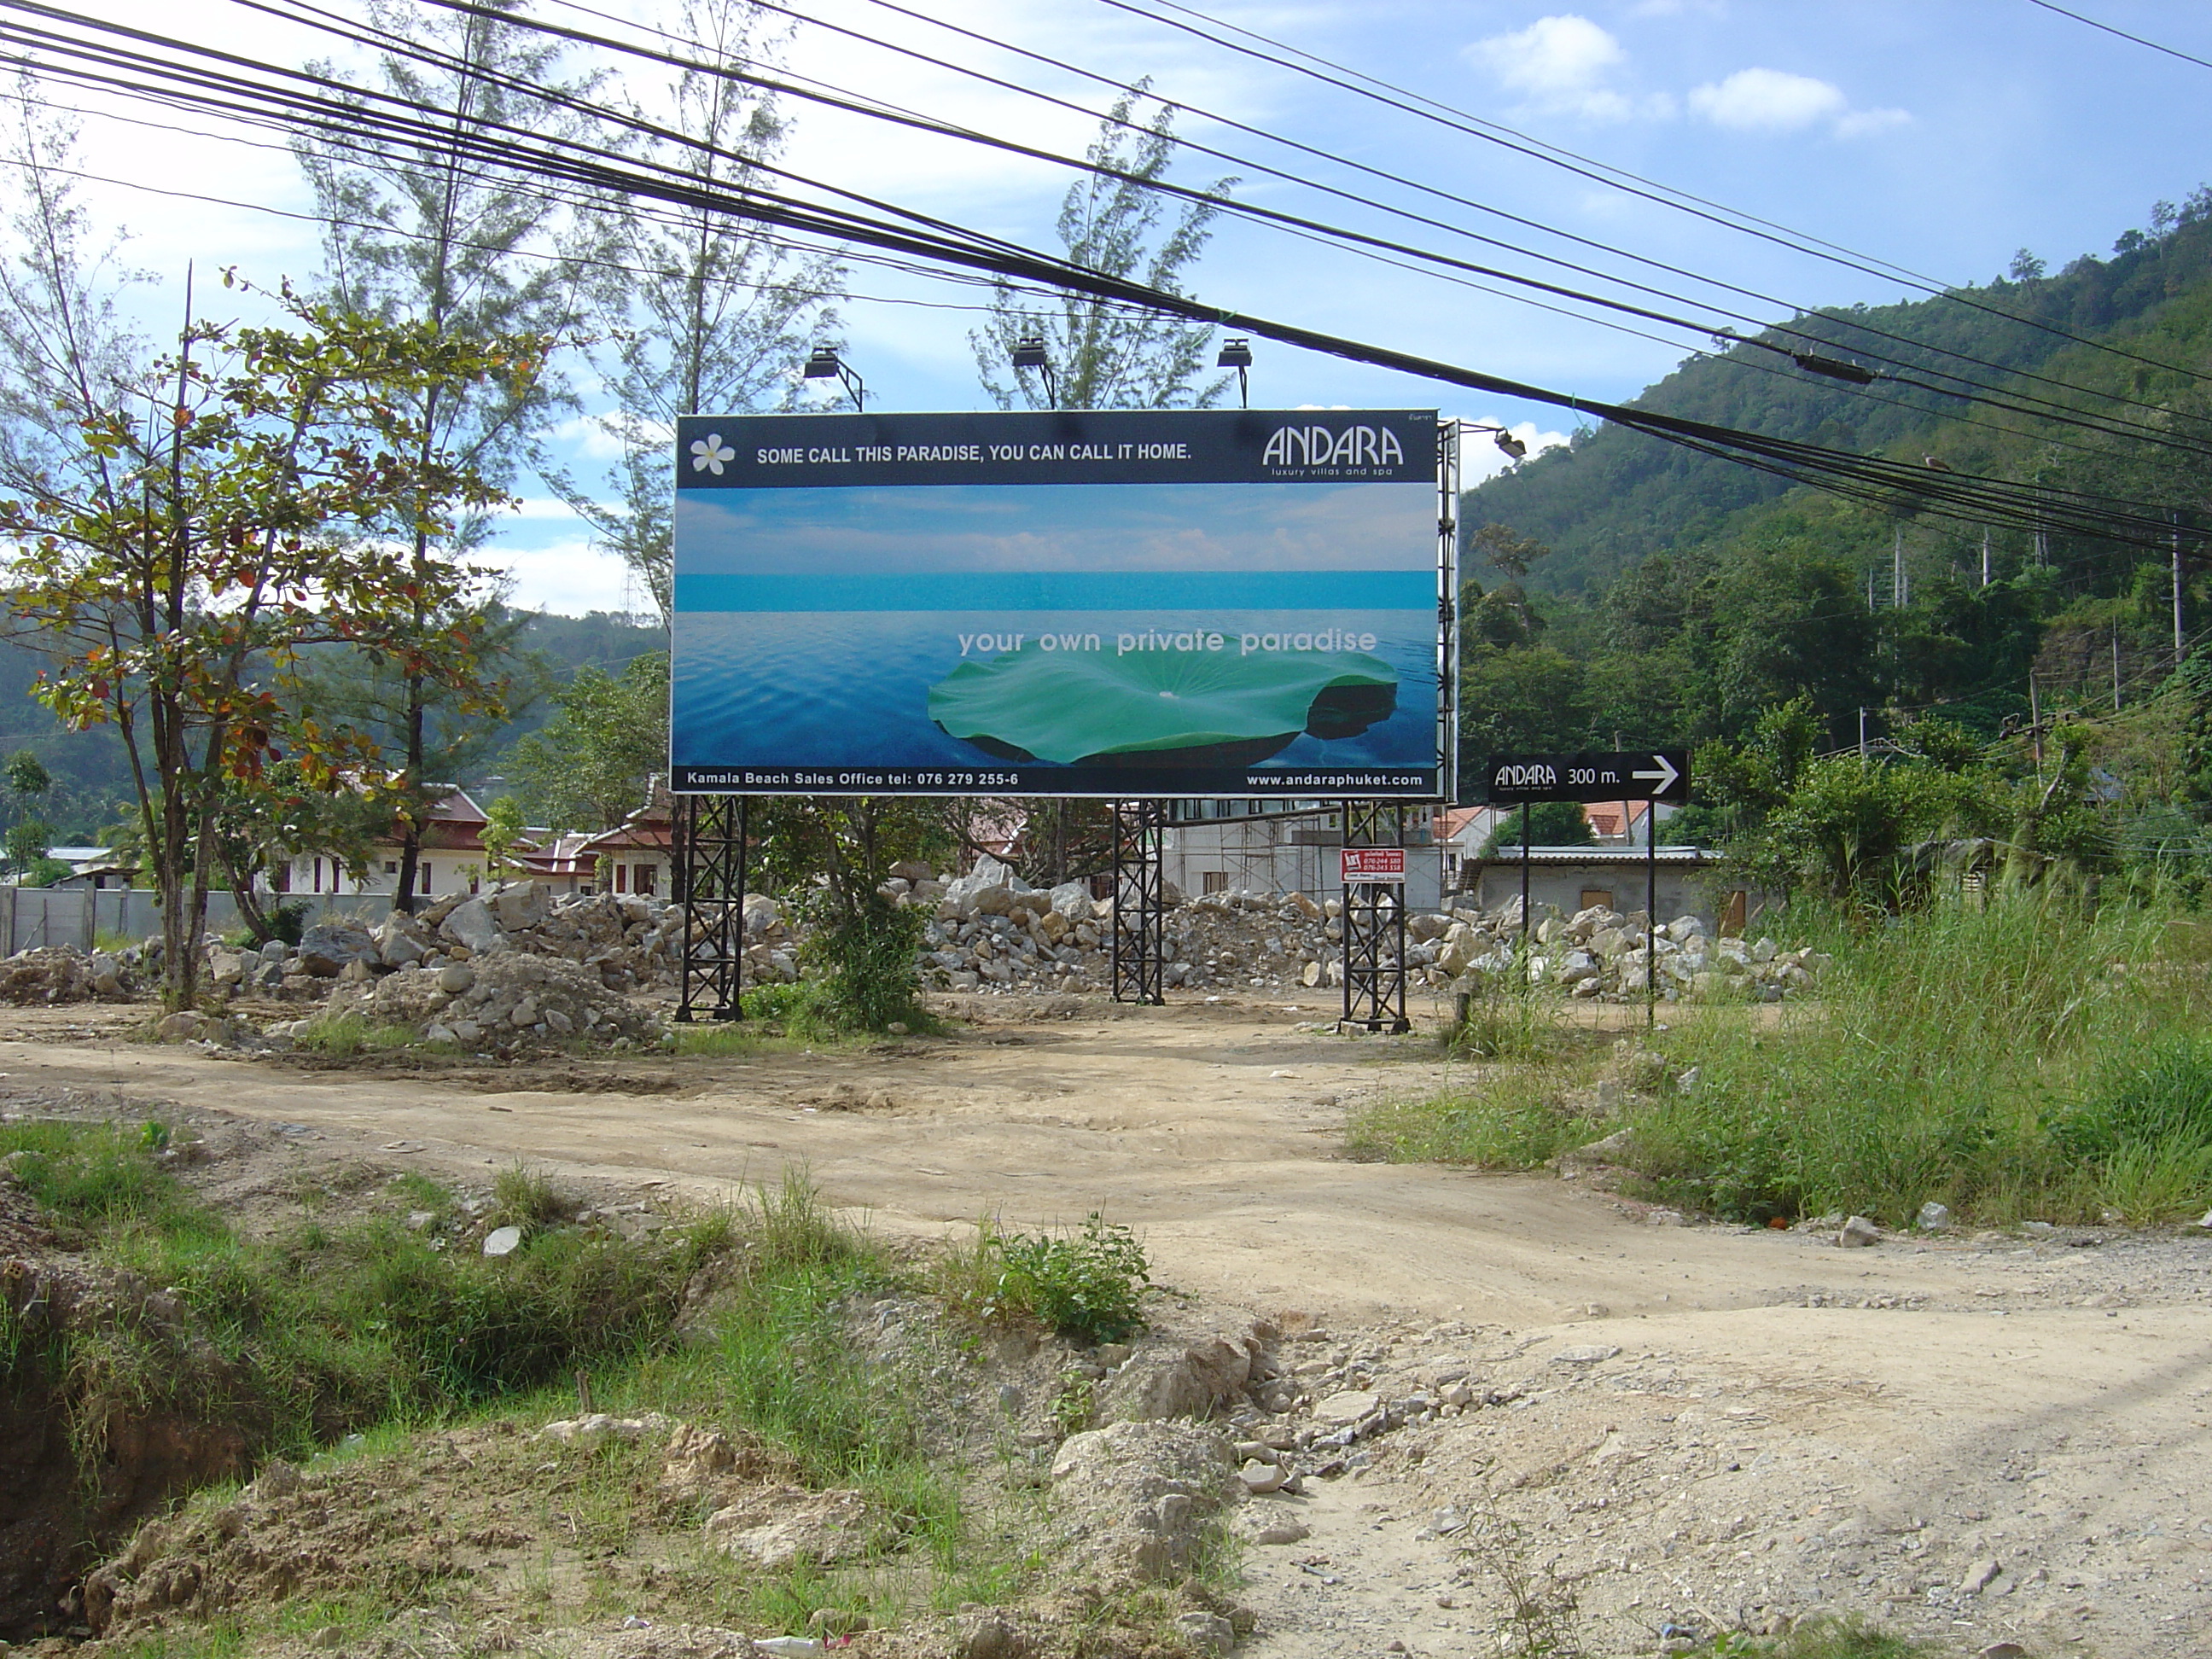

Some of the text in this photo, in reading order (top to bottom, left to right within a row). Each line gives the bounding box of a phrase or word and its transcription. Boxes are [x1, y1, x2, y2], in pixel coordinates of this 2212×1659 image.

[757, 443, 1191, 464] SOME CALL THIS PARADISE, YOU CAN CALL IT HOME.
[1262, 425, 1404, 466] ANDARA
[1272, 468, 1305, 476] luxury
[958, 628, 1377, 656] your own private paradise
[687, 771, 1018, 785] Kamala Beach Sales Office tel: 076 279 255-6
[1246, 773, 1423, 788] www.andaraphuket.com
[1494, 764, 1621, 786] ANDARA 300 m.
